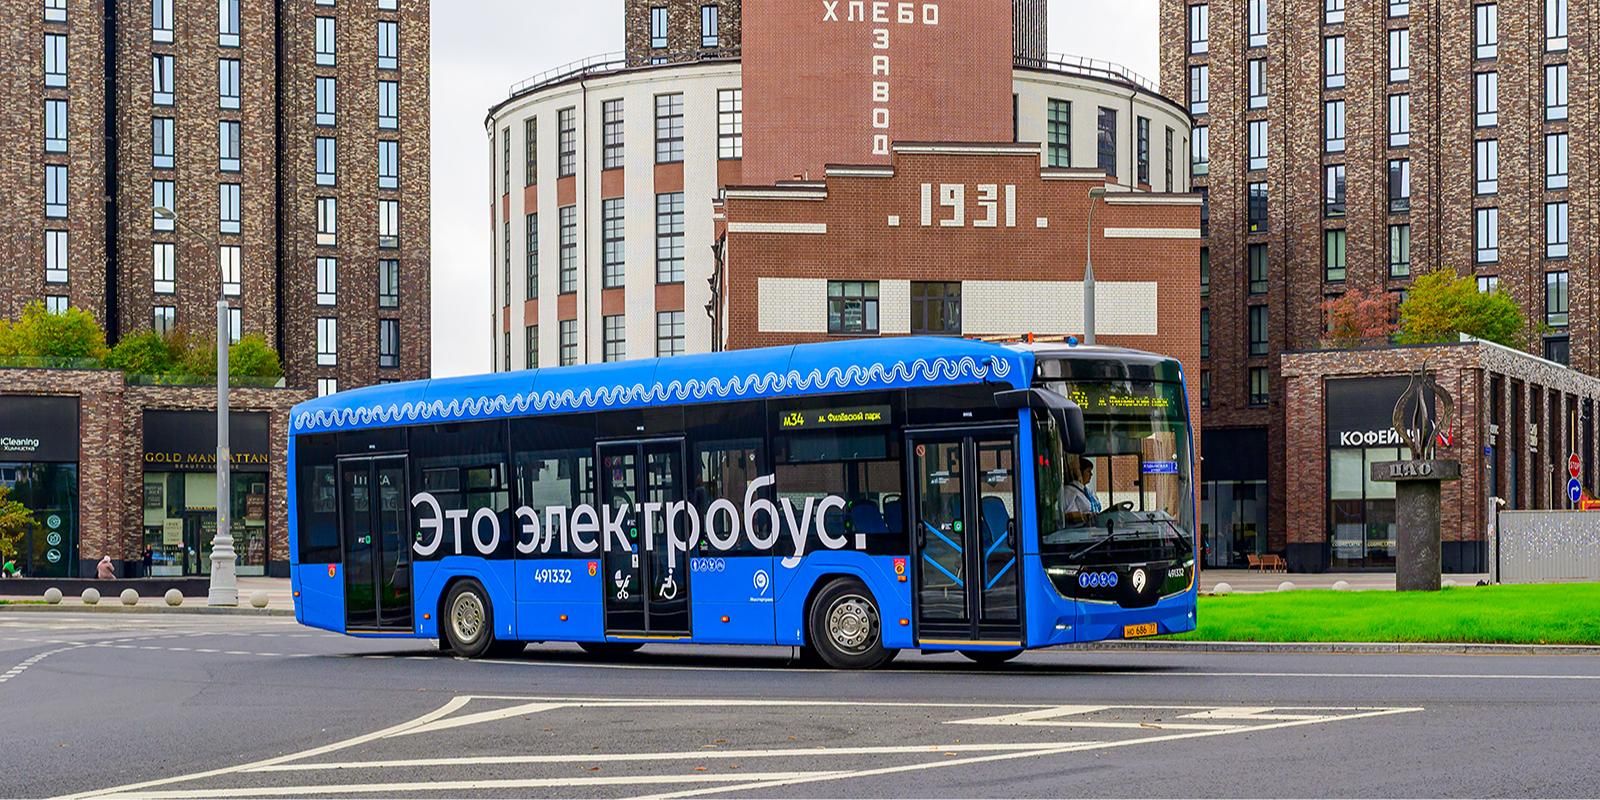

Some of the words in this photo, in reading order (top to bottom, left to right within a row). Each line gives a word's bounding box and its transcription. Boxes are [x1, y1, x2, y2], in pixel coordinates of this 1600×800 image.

[822, 0, 939, 25] ХЛЕБО
[872, 28, 890, 156] ЗАВОД
[920, 183, 1017, 227] 1931
[864, 412, 880, 421] парк
[145, 452, 182, 463] GOLD
[187, 453, 269, 464] MANATTAN
[1389, 463, 1432, 478] ЦАО
[411, 491, 500, 556] Это
[516, 473, 867, 569] электробус.
[534, 568, 572, 584] 491332
[1168, 568, 1184, 577] 491332
